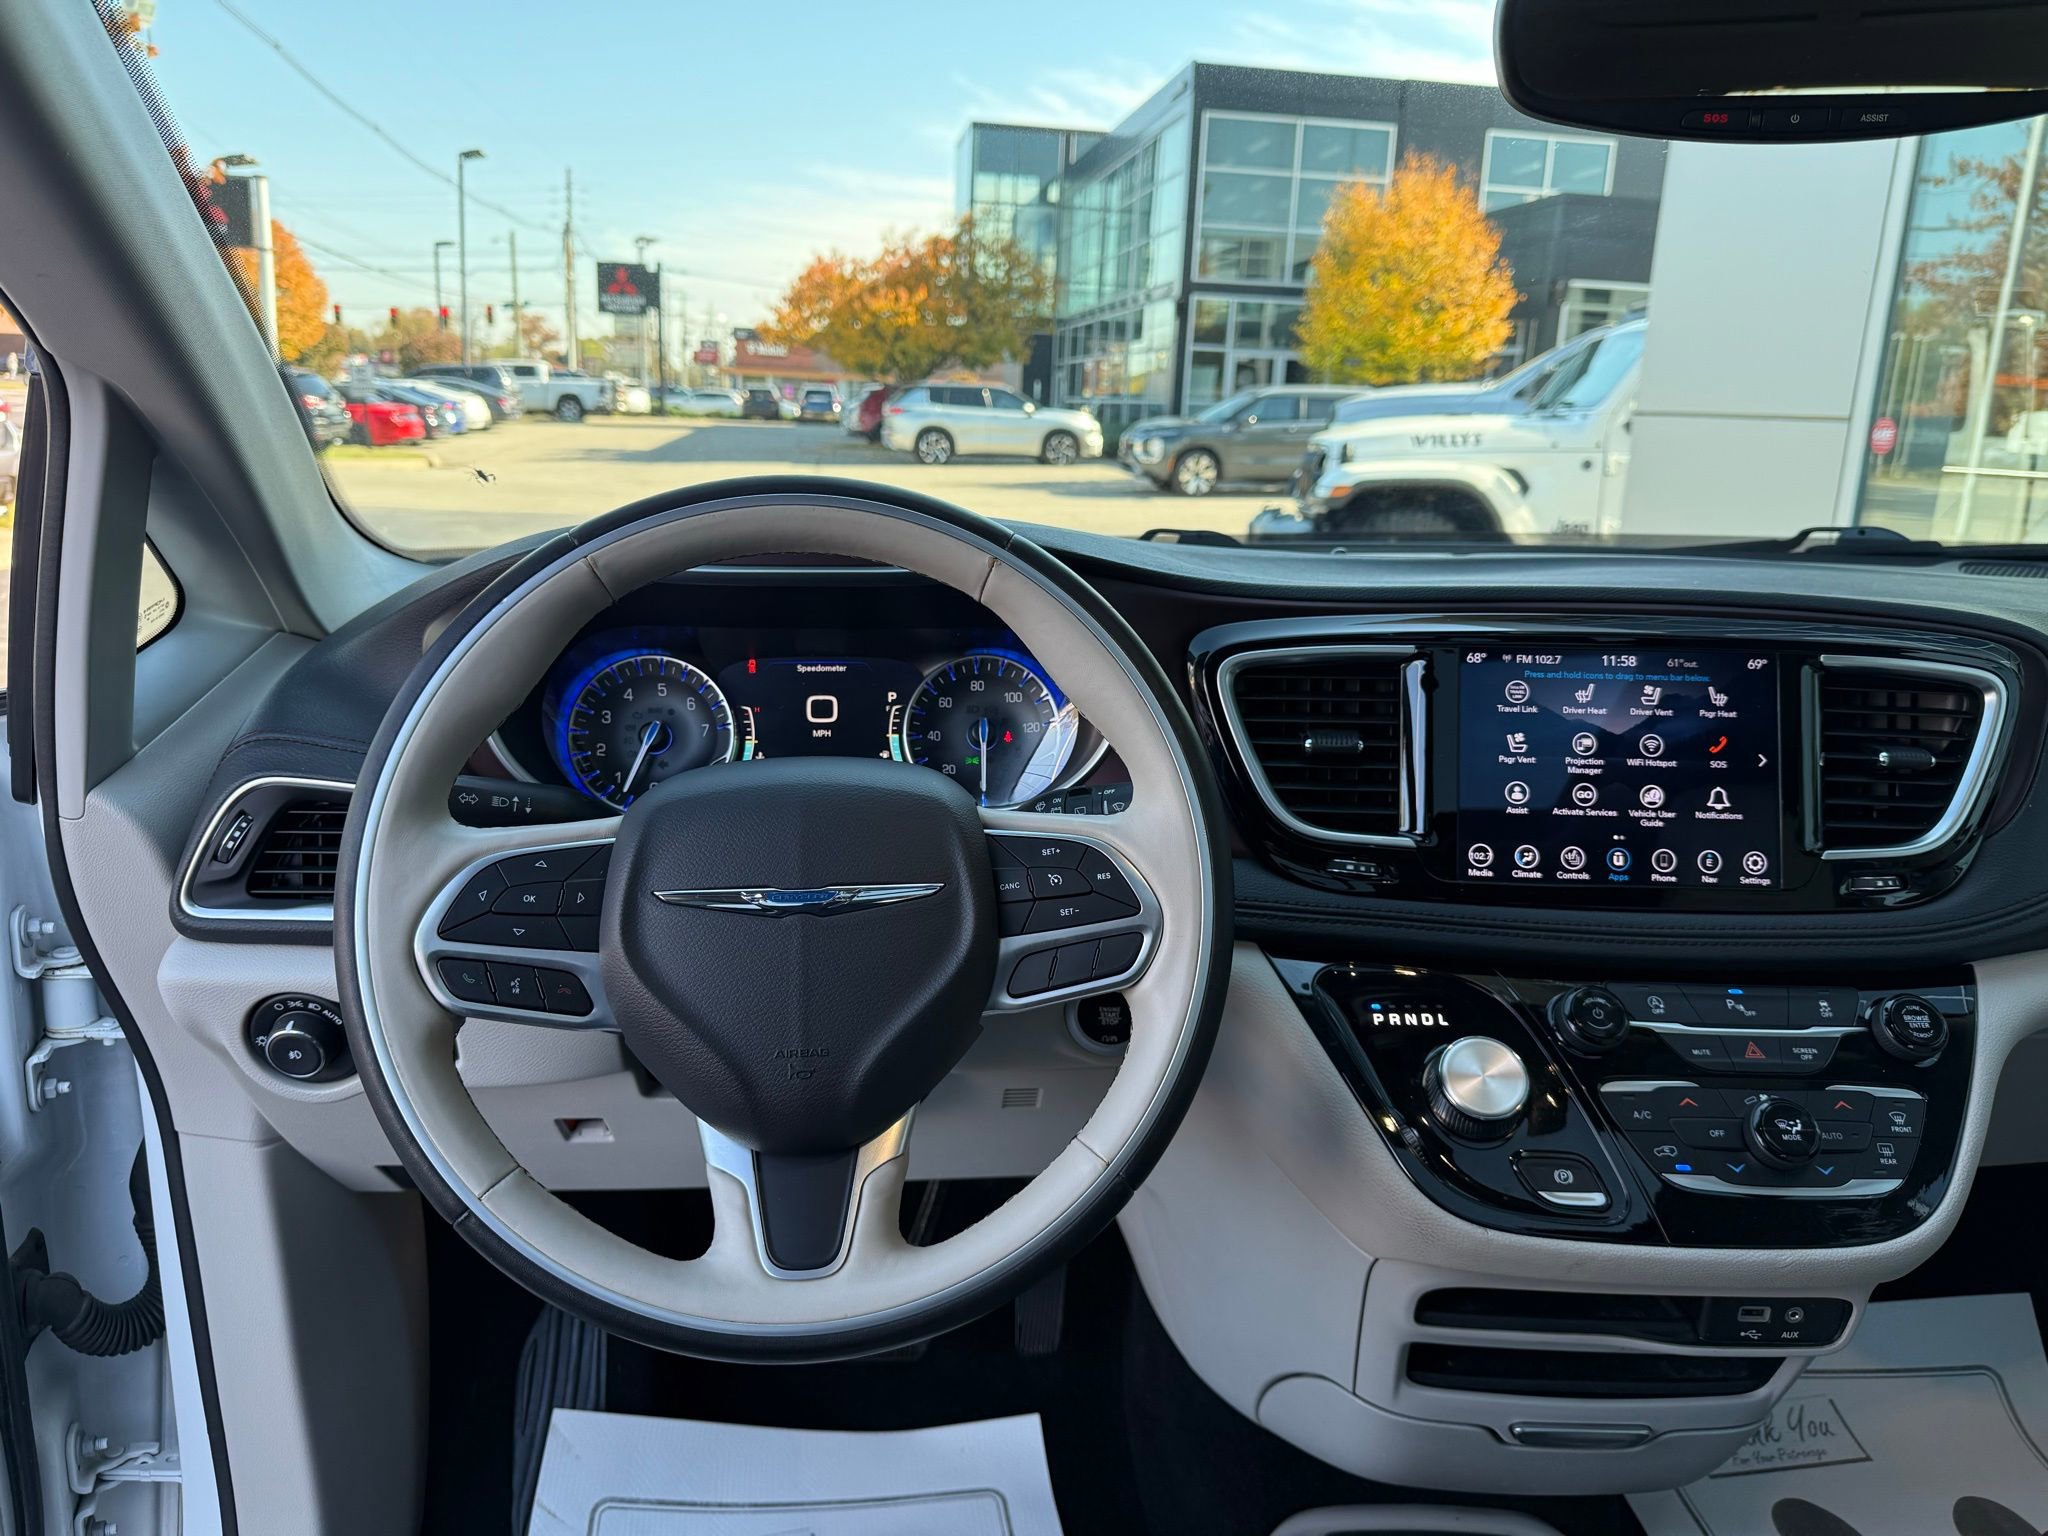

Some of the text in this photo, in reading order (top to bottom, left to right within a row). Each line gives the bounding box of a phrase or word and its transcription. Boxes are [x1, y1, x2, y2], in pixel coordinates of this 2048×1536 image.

[1703, 113, 1728, 123] SOS
[1860, 114, 1889, 122] ASSIST
[1516, 655, 1562, 665] FM 102.7
[1602, 655, 1638, 667] 11:58
[797, 664, 847, 674] Speedometer
[1524, 670, 1545, 679] Press
[1547, 670, 1562, 679] and
[1564, 671, 1582, 679] hold
[1583, 671, 1604, 680] icons
[1605, 672, 1614, 680] to
[1615, 672, 1634, 682] drag
[1635, 673, 1644, 681] to
[1670, 673, 1683, 682] bar
[658, 683, 667, 697] 5
[970, 680, 985, 692] 80
[623, 688, 634, 701] 4
[887, 692, 897, 703] P
[1004, 692, 1023, 703] 100
[686, 697, 696, 711] 6
[938, 697, 953, 708] 60
[805, 694, 838, 723] 0
[1497, 704, 1538, 713] Travel Link
[1562, 706, 1608, 715] Driver Heat
[1630, 708, 1674, 717] Driver Vent
[601, 710, 612, 724] 3
[1699, 709, 1737, 719] Psgr Heat
[701, 723, 710, 737] 7
[1023, 722, 1041, 733] 120
[812, 729, 832, 738] MPH
[927, 730, 941, 741] 40
[596, 743, 606, 757] 2
[1499, 755, 1536, 764] Psgr Vent
[1565, 757, 1604, 766] Projection
[1626, 758, 1678, 768] WiFi Hotspot
[942, 764, 956, 775] 20
[1567, 766, 1603, 776] Manager
[614, 771, 622, 783] 1
[1576, 790, 1593, 799] GO
[1505, 806, 1529, 815] Assist
[1552, 808, 1619, 817] Activate Services
[1628, 809, 1676, 818] Vehicle User
[1695, 811, 1743, 820] Notifications
[1640, 819, 1665, 828] Guide
[1469, 852, 1491, 860] 102.7
[1097, 872, 1112, 881] RES
[1468, 868, 1494, 877] Media
[1512, 869, 1543, 879] Climate
[1556, 871, 1591, 880] Controls
[1608, 872, 1629, 882] Apps
[1651, 873, 1677, 882] Phone
[1701, 875, 1717, 883] Nav
[1739, 876, 1771, 886] Settings
[1000, 881, 1020, 891] CANC
[523, 894, 536, 903] OK
[322, 1009, 343, 1026] AUTO
[773, 1048, 829, 1059] AIRBAG
[1691, 1048, 1711, 1056] MUTE
[1792, 1047, 1818, 1055] SCREEN
[1633, 1110, 1652, 1120] A/C
[1709, 1129, 1725, 1138] OFF
[1891, 1125, 1912, 1133] FRONT
[1821, 1132, 1843, 1140] AUTO
[1880, 1157, 1897, 1165] REAR
[1781, 1331, 1799, 1339] AUX
[1787, 1404, 1837, 1442] You
